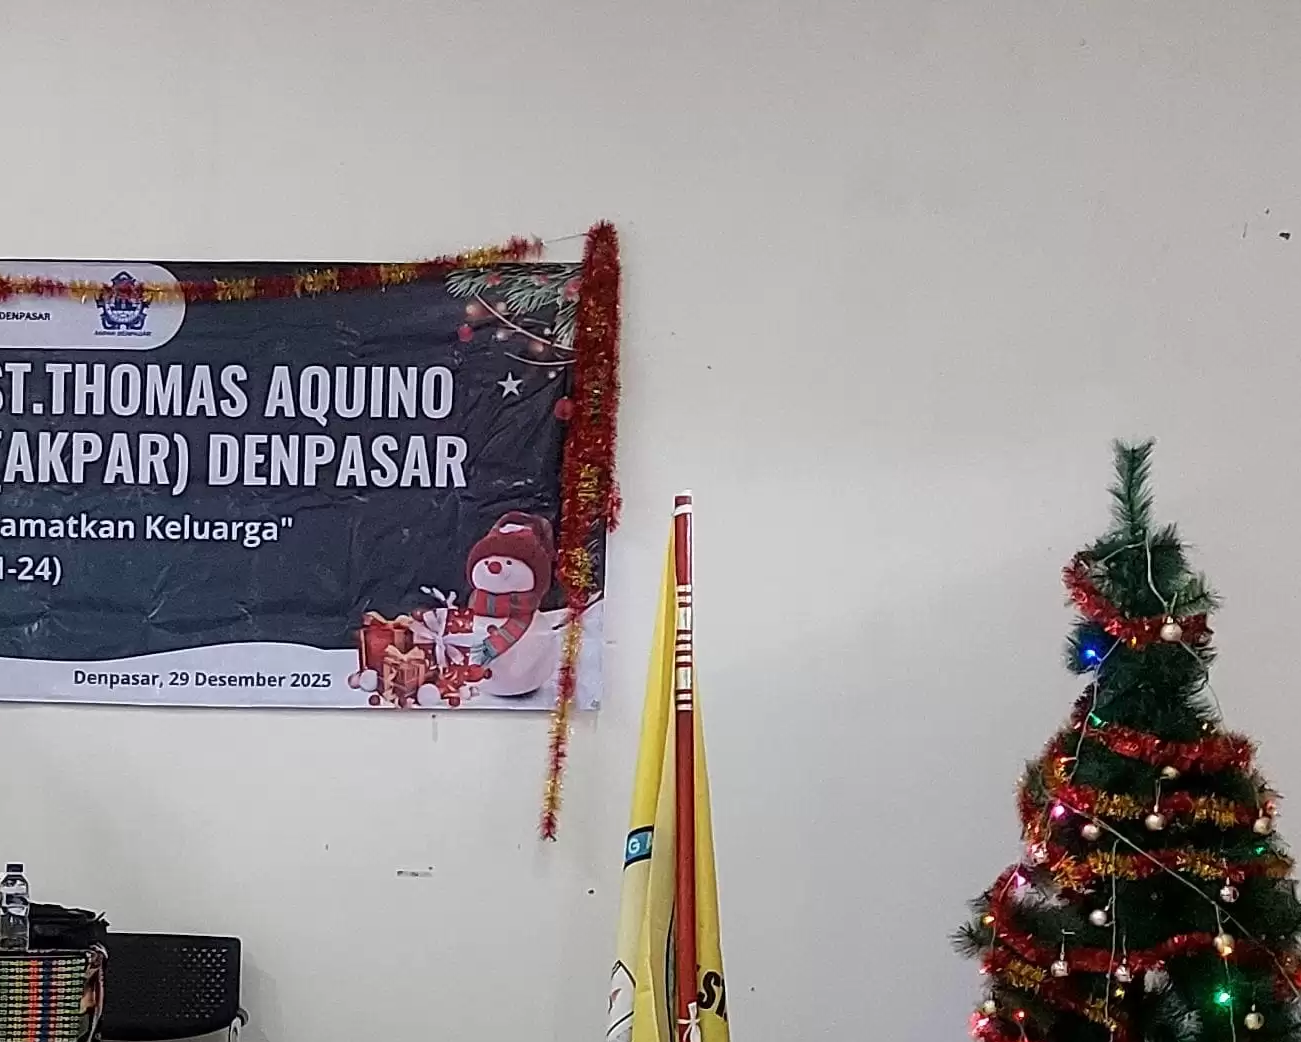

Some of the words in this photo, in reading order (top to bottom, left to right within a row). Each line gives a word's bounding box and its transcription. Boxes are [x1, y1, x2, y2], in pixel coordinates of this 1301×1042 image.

[0, 312, 51, 321] DENPASAR
[264, 364, 455, 427] AQUINO
[207, 434, 468, 489] DENPASAR
[145, 514, 295, 548] Keluarga"
[73, 669, 164, 690] Denpasar,
[168, 671, 190, 687] 29
[195, 671, 285, 688] Desember
[289, 672, 332, 689] 2025
